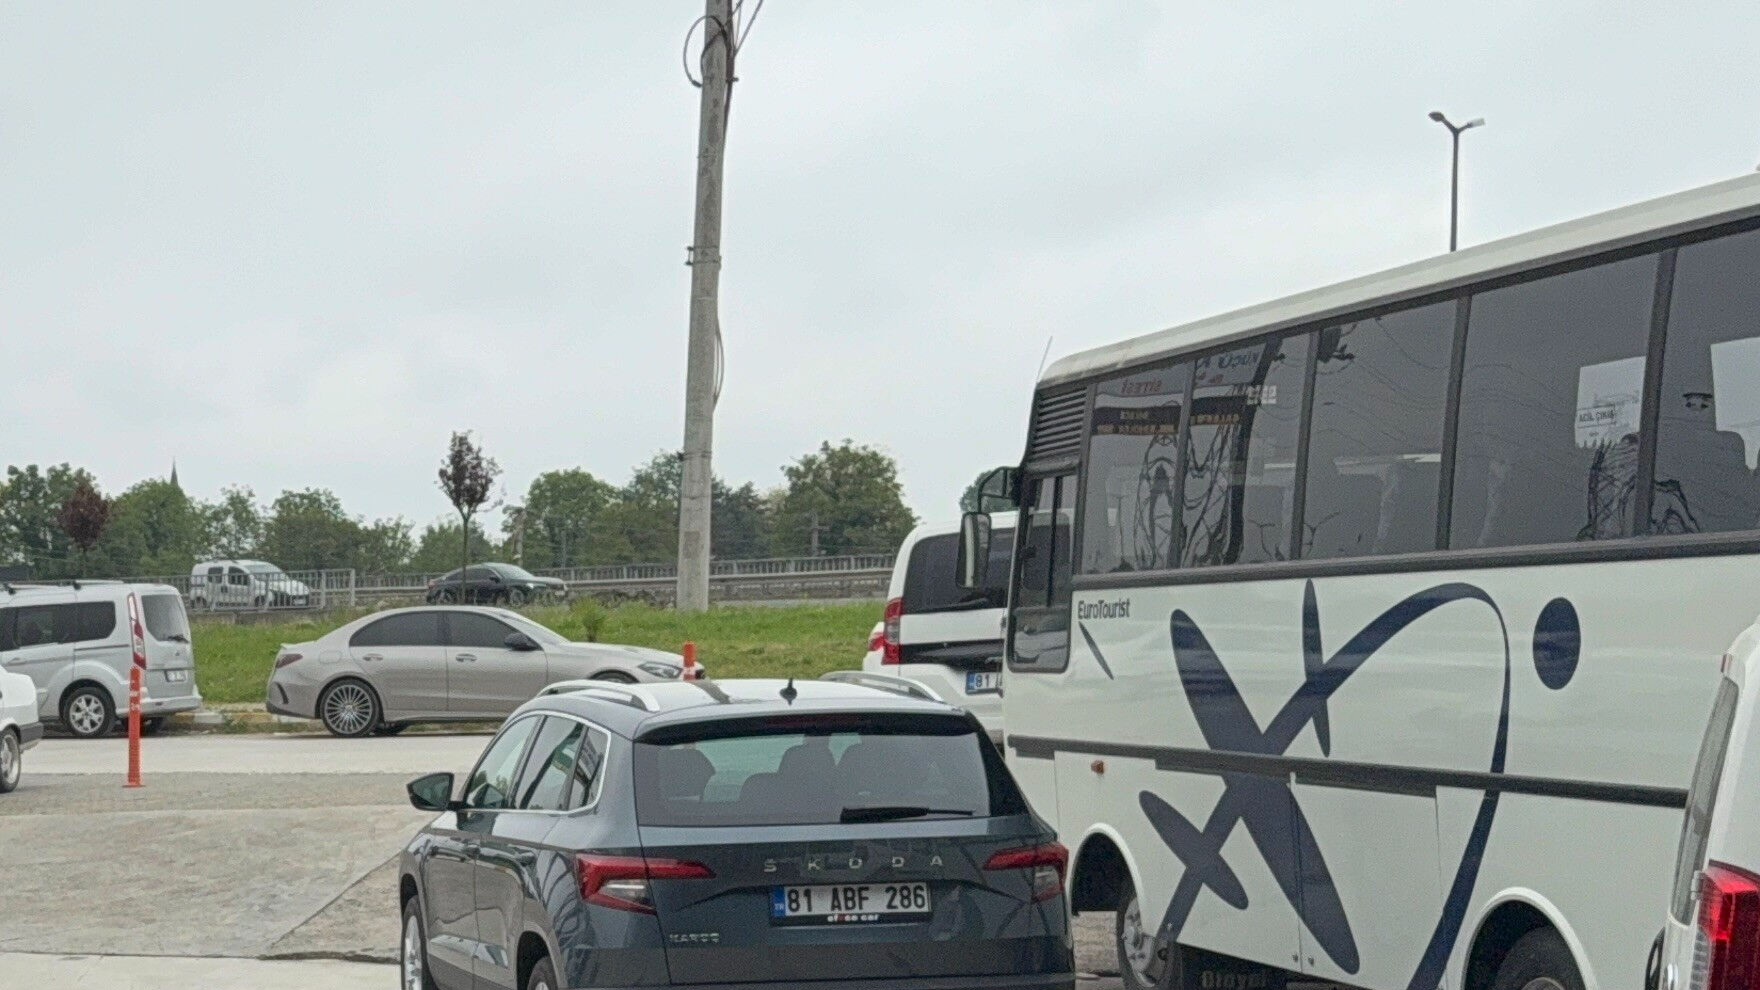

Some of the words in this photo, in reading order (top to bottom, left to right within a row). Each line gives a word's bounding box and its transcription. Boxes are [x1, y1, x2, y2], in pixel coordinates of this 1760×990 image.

[1078, 598, 1130, 619] EuroTourist
[787, 888, 813, 913] 81
[830, 886, 871, 912] ABF
[884, 885, 926, 910] 286
